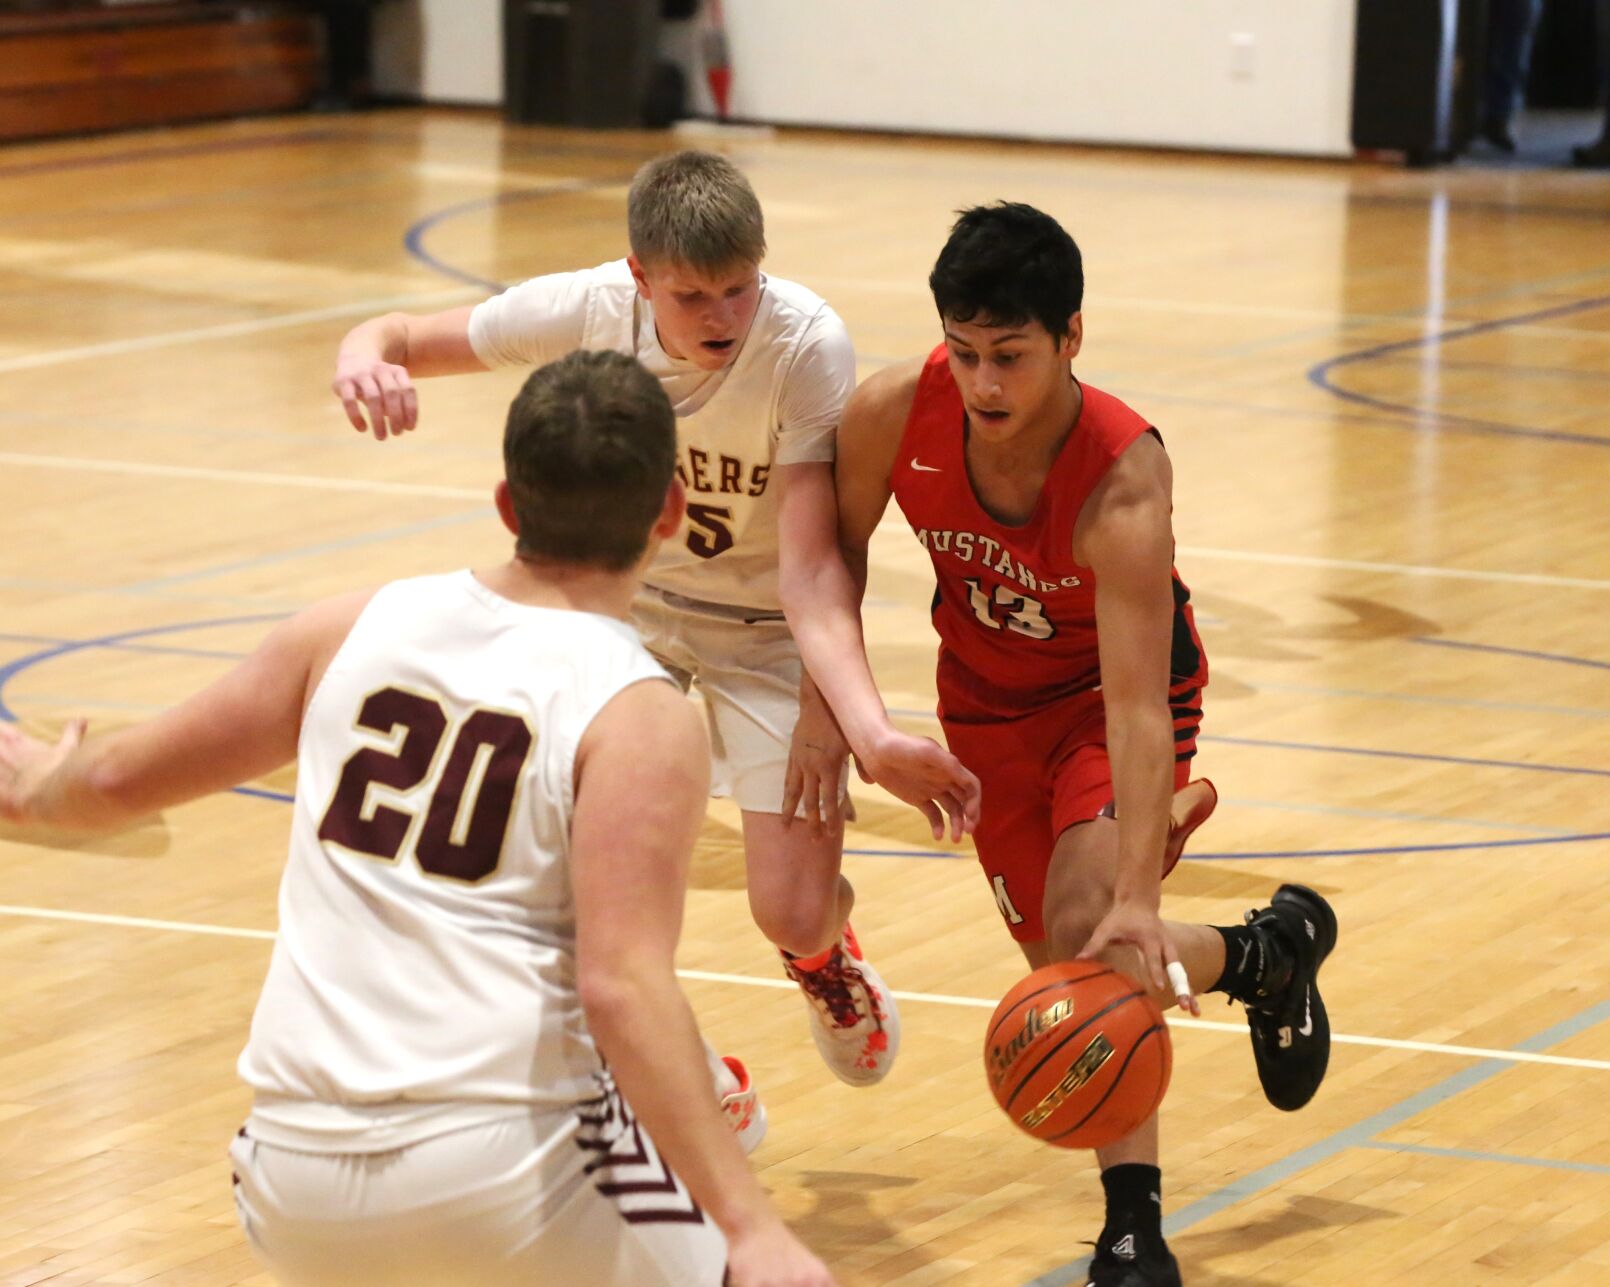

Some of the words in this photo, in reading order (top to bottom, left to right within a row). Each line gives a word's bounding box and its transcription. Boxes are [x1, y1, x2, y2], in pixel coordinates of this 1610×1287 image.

[676, 447, 771, 497] ERS
[686, 502, 734, 559] 5
[963, 577, 1056, 640] 13
[317, 686, 534, 883] 20
